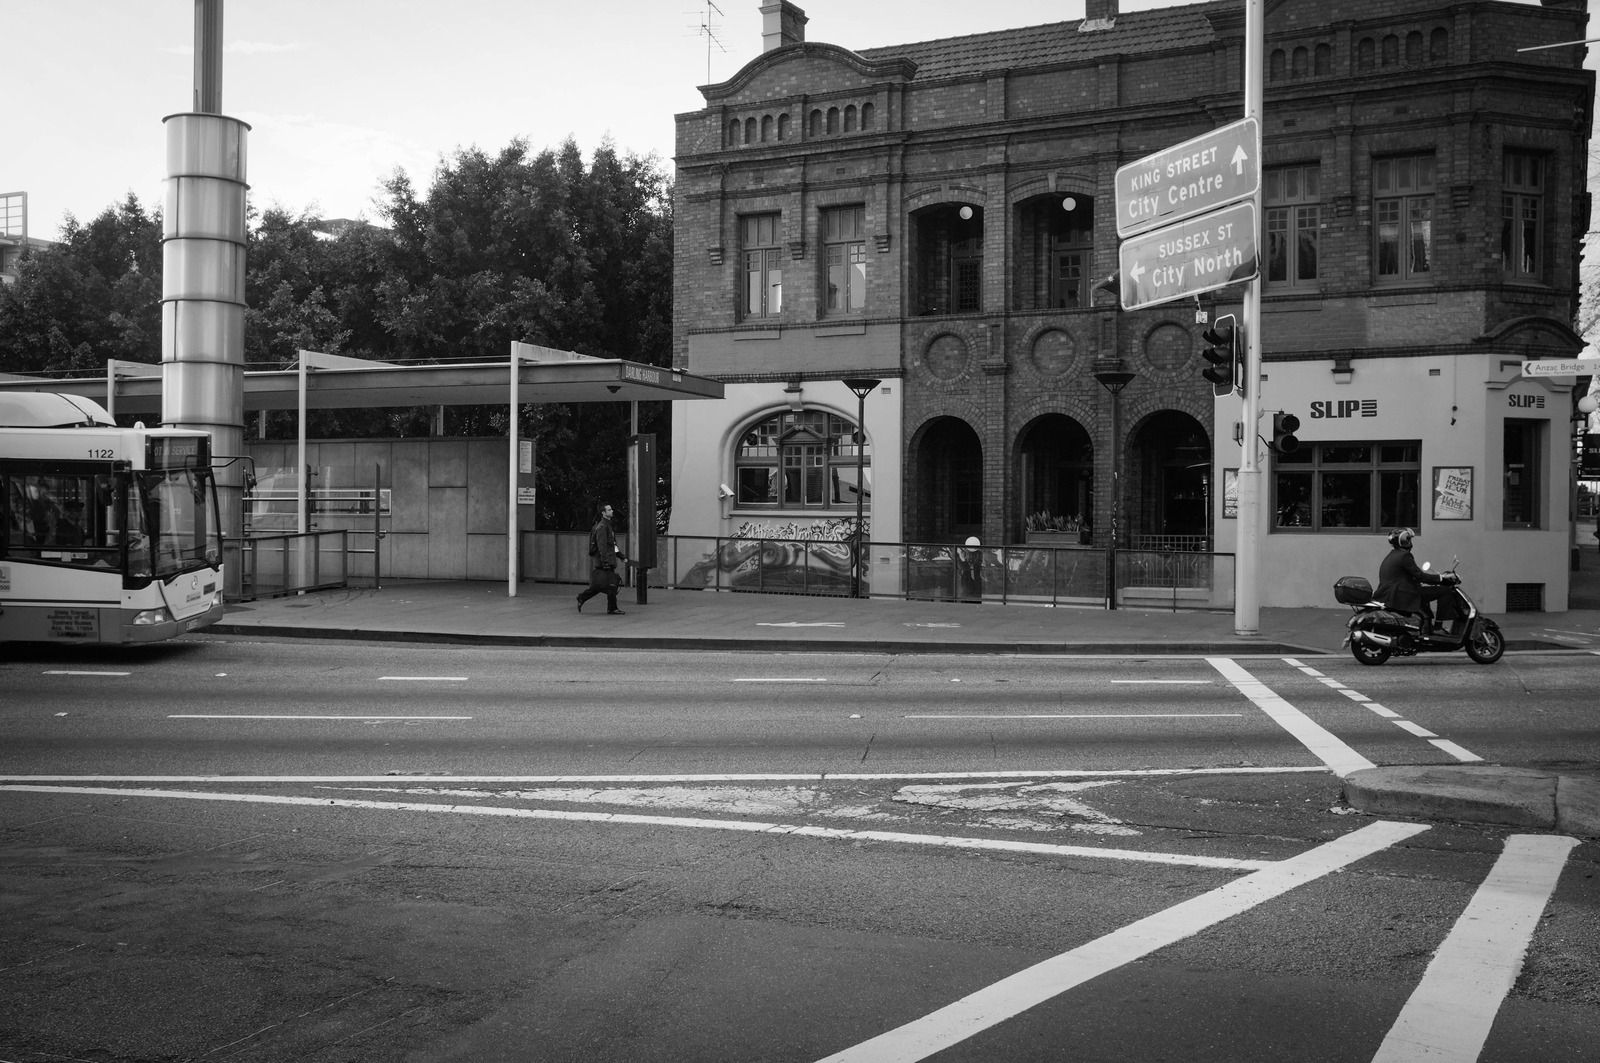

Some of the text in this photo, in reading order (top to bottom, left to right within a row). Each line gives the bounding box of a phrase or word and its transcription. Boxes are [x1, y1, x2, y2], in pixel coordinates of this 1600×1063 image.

[1131, 146, 1218, 192] KING STREET
[1129, 174, 1223, 218] City Centre
[1159, 223, 1233, 258] SUSSEX ST
[1152, 246, 1243, 287] City North
[625, 365, 642, 381] DARLING
[642, 368, 660, 383] HARBOUR
[1560, 363, 1585, 372] Bridge
[1310, 400, 1360, 419] SLIP
[1508, 394, 1536, 408] SLIP
[87, 449, 114, 459] 1122
[1447, 480, 1469, 489] HAPPY
[1448, 475, 1471, 484] FRIDAY
